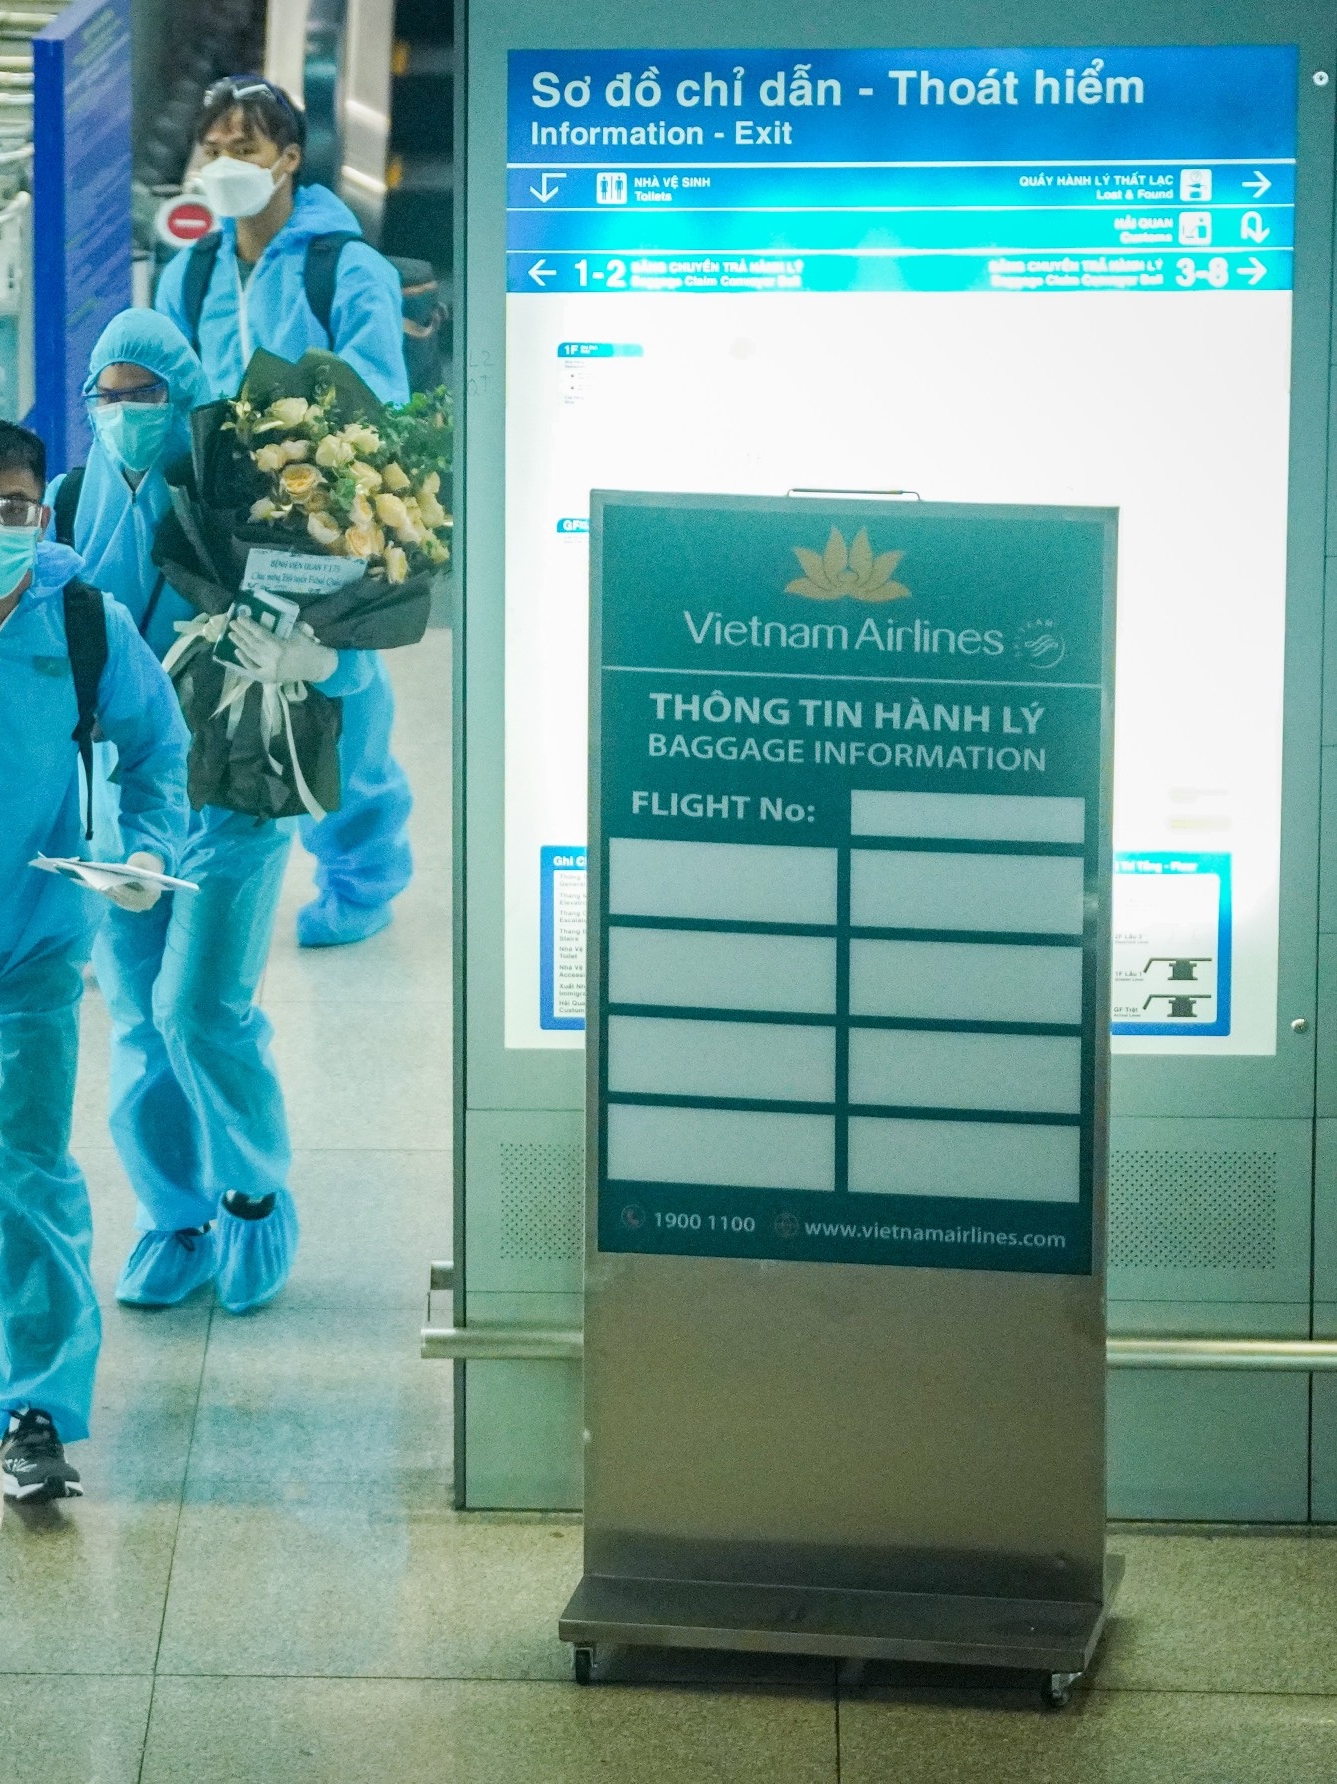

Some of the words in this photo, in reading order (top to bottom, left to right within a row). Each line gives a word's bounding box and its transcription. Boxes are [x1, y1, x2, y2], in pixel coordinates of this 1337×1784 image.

[532, 71, 591, 108] Sơ
[605, 66, 662, 107] đồ
[676, 66, 745, 107] chỉ
[759, 63, 841, 106] dẫn
[859, 87, 873, 96] -
[888, 68, 1019, 106] Thoát
[1035, 58, 1144, 104] hiểm
[531, 121, 703, 145] Information
[735, 120, 792, 145] Exit
[634, 175, 660, 188] NHÀ
[662, 174, 679, 190] VỆ
[682, 176, 711, 188] SINH
[1019, 172, 1053, 186] QUẦY
[1057, 172, 1092, 186] HÀNH
[1095, 172, 1111, 186] LÝ
[1113, 171, 1145, 185] THẤT
[1149, 174, 1174, 187] LẠC
[1096, 189, 1123, 200] Lost
[1137, 188, 1174, 200] Found
[634, 190, 673, 202] Toilets
[575, 258, 627, 288] 1-2
[1176, 257, 1229, 287] 3-8
[682, 610, 850, 651] Vietnam
[854, 616, 1005, 656] Airlines
[649, 689, 791, 726] THÔNG
[799, 698, 862, 728] TIN
[875, 697, 990, 733] HÀNH
[1003, 701, 1046, 735] LÝ
[648, 733, 804, 764] BAGGAGE
[815, 739, 1047, 772] INFORMATION
[632, 790, 751, 820] FLIGHT
[760, 797, 815, 823] No:
[654, 1211, 701, 1231] 1900
[708, 1213, 755, 1233] 1100
[804, 1219, 1067, 1249] www.vietnamairlines.com
